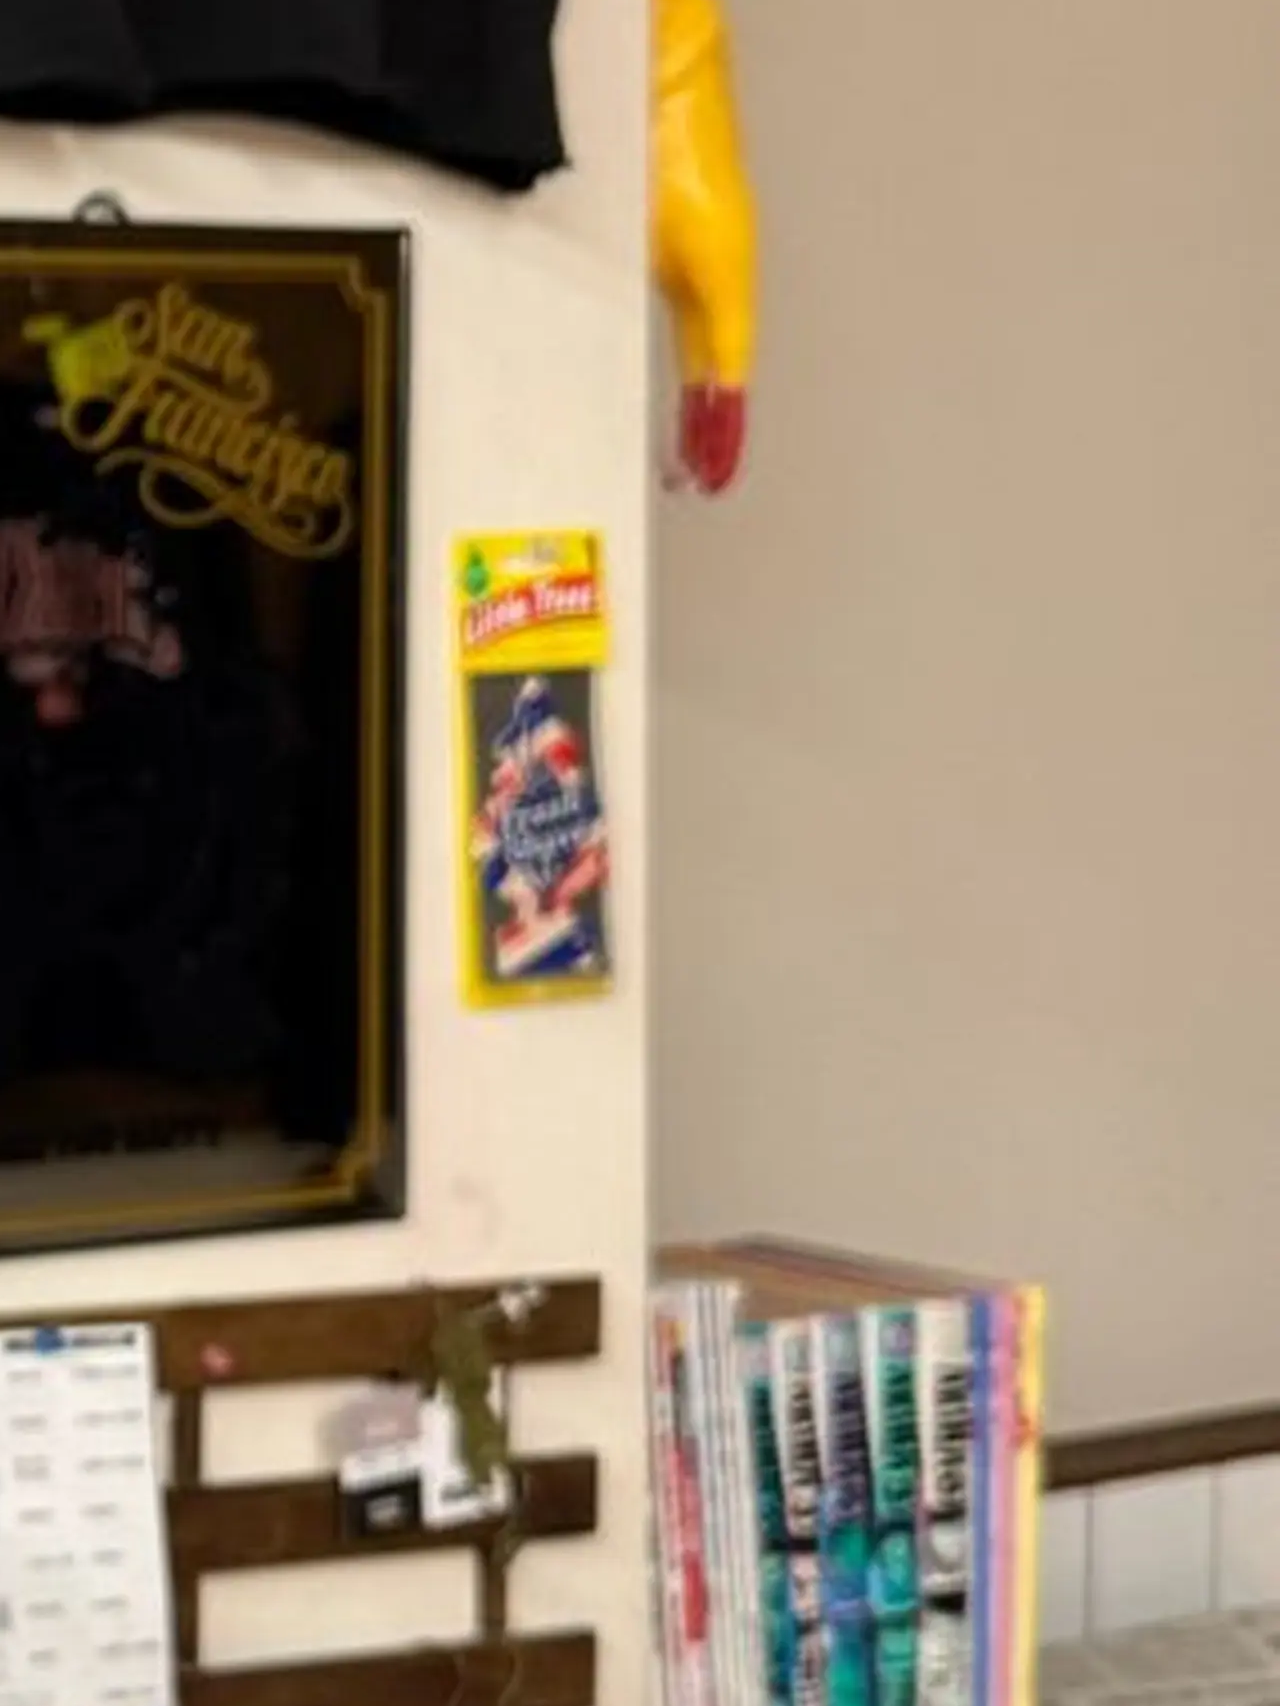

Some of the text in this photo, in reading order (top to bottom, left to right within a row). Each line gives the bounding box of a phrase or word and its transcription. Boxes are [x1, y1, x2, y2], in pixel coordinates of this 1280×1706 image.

[112, 281, 272, 415] San
[58, 355, 352, 557] Francisco
[466, 579, 594, 645] Little Trees
